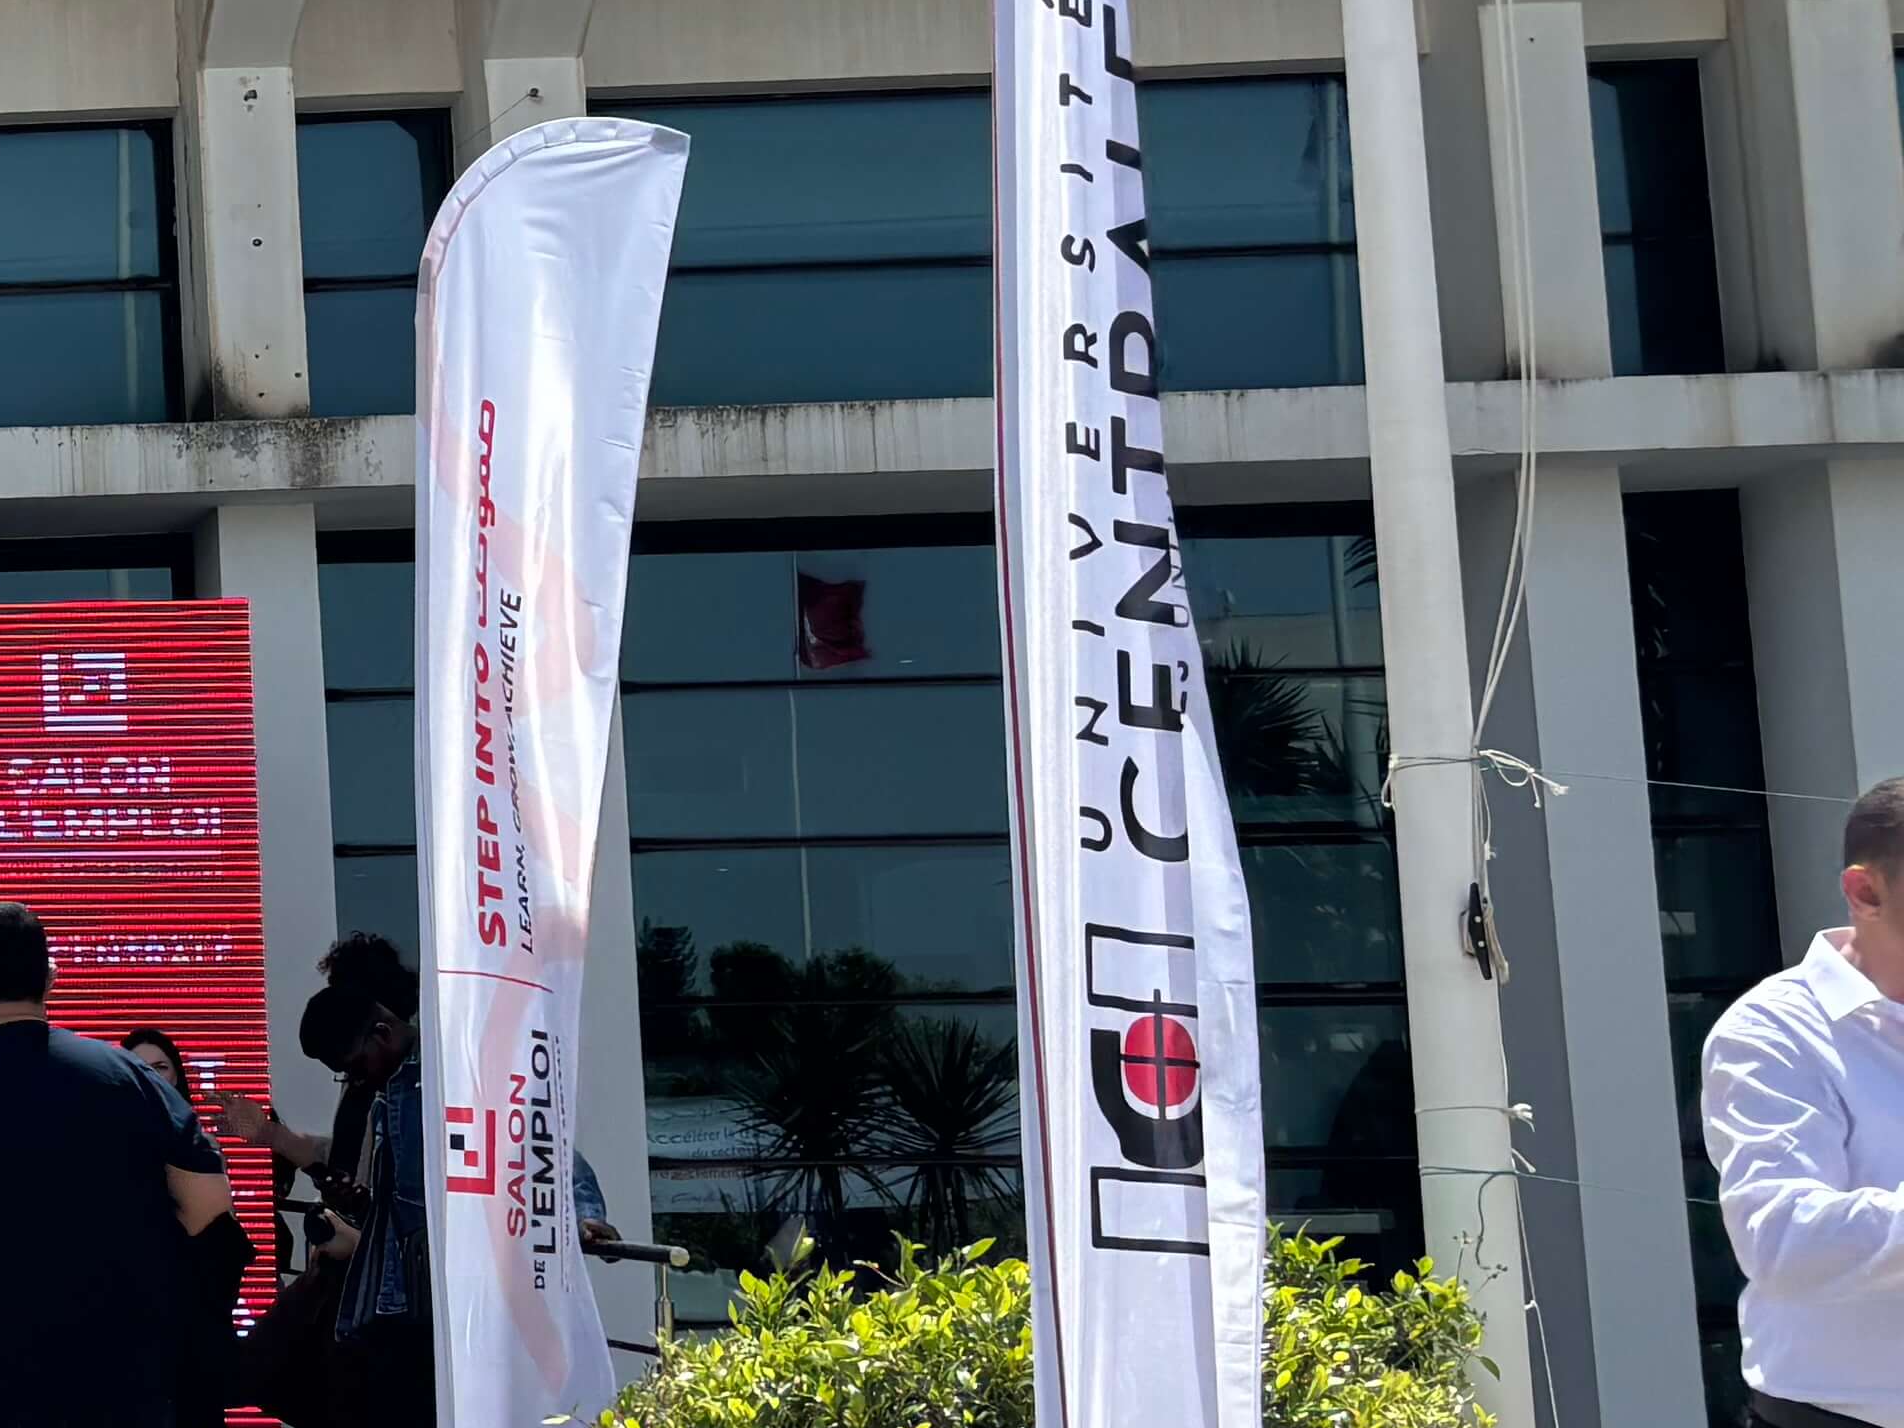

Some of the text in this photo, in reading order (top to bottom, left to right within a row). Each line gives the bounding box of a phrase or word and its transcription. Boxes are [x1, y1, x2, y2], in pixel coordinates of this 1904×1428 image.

[7, 756, 172, 795] SALON
[475, 641, 507, 947] STEP INTO
[507, 1074, 527, 1238] SALON
[530, 1029, 557, 1291] DE L'EMPLOI
